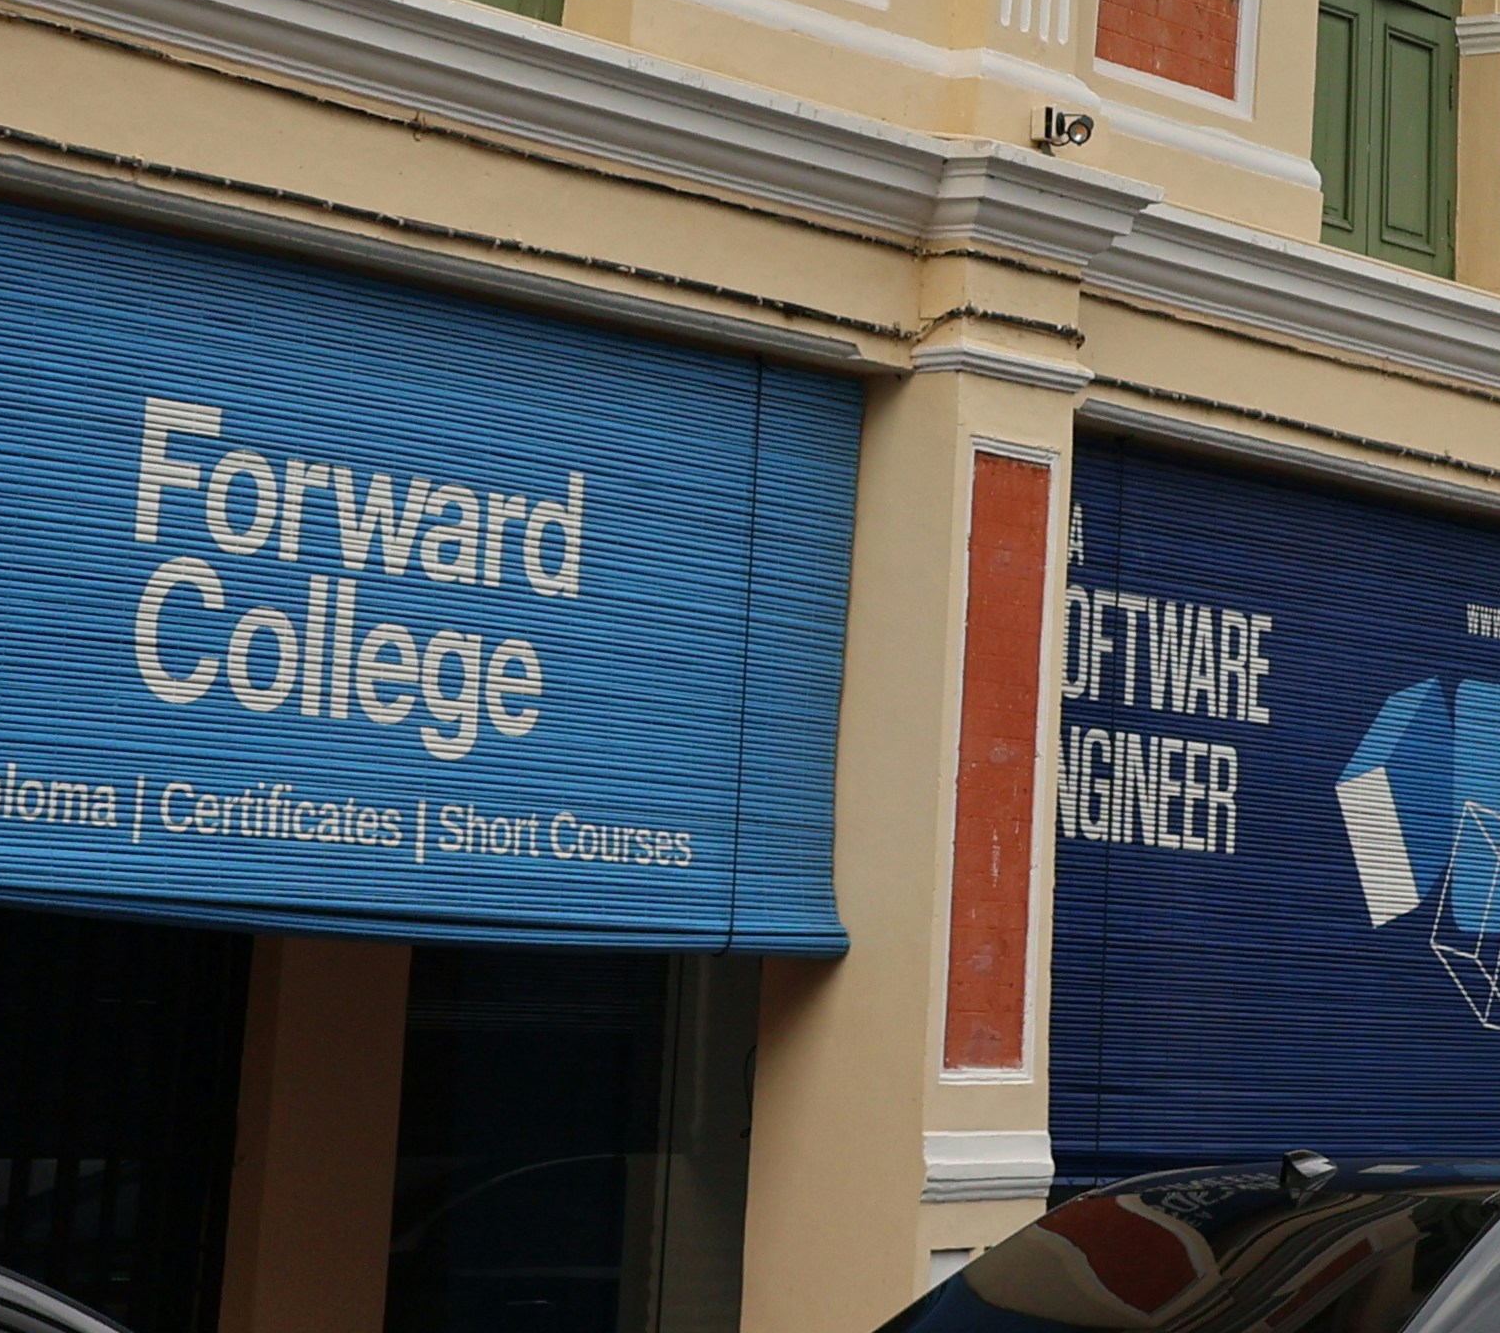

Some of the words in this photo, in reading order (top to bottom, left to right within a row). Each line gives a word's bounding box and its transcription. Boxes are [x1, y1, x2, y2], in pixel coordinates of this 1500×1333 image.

[134, 396, 584, 599] Forward
[134, 556, 543, 760] College
[1062, 585, 1272, 724] OFTWARE
[160, 780, 403, 848] Certificates
[438, 803, 540, 859] Short
[549, 810, 692, 867] Courses
